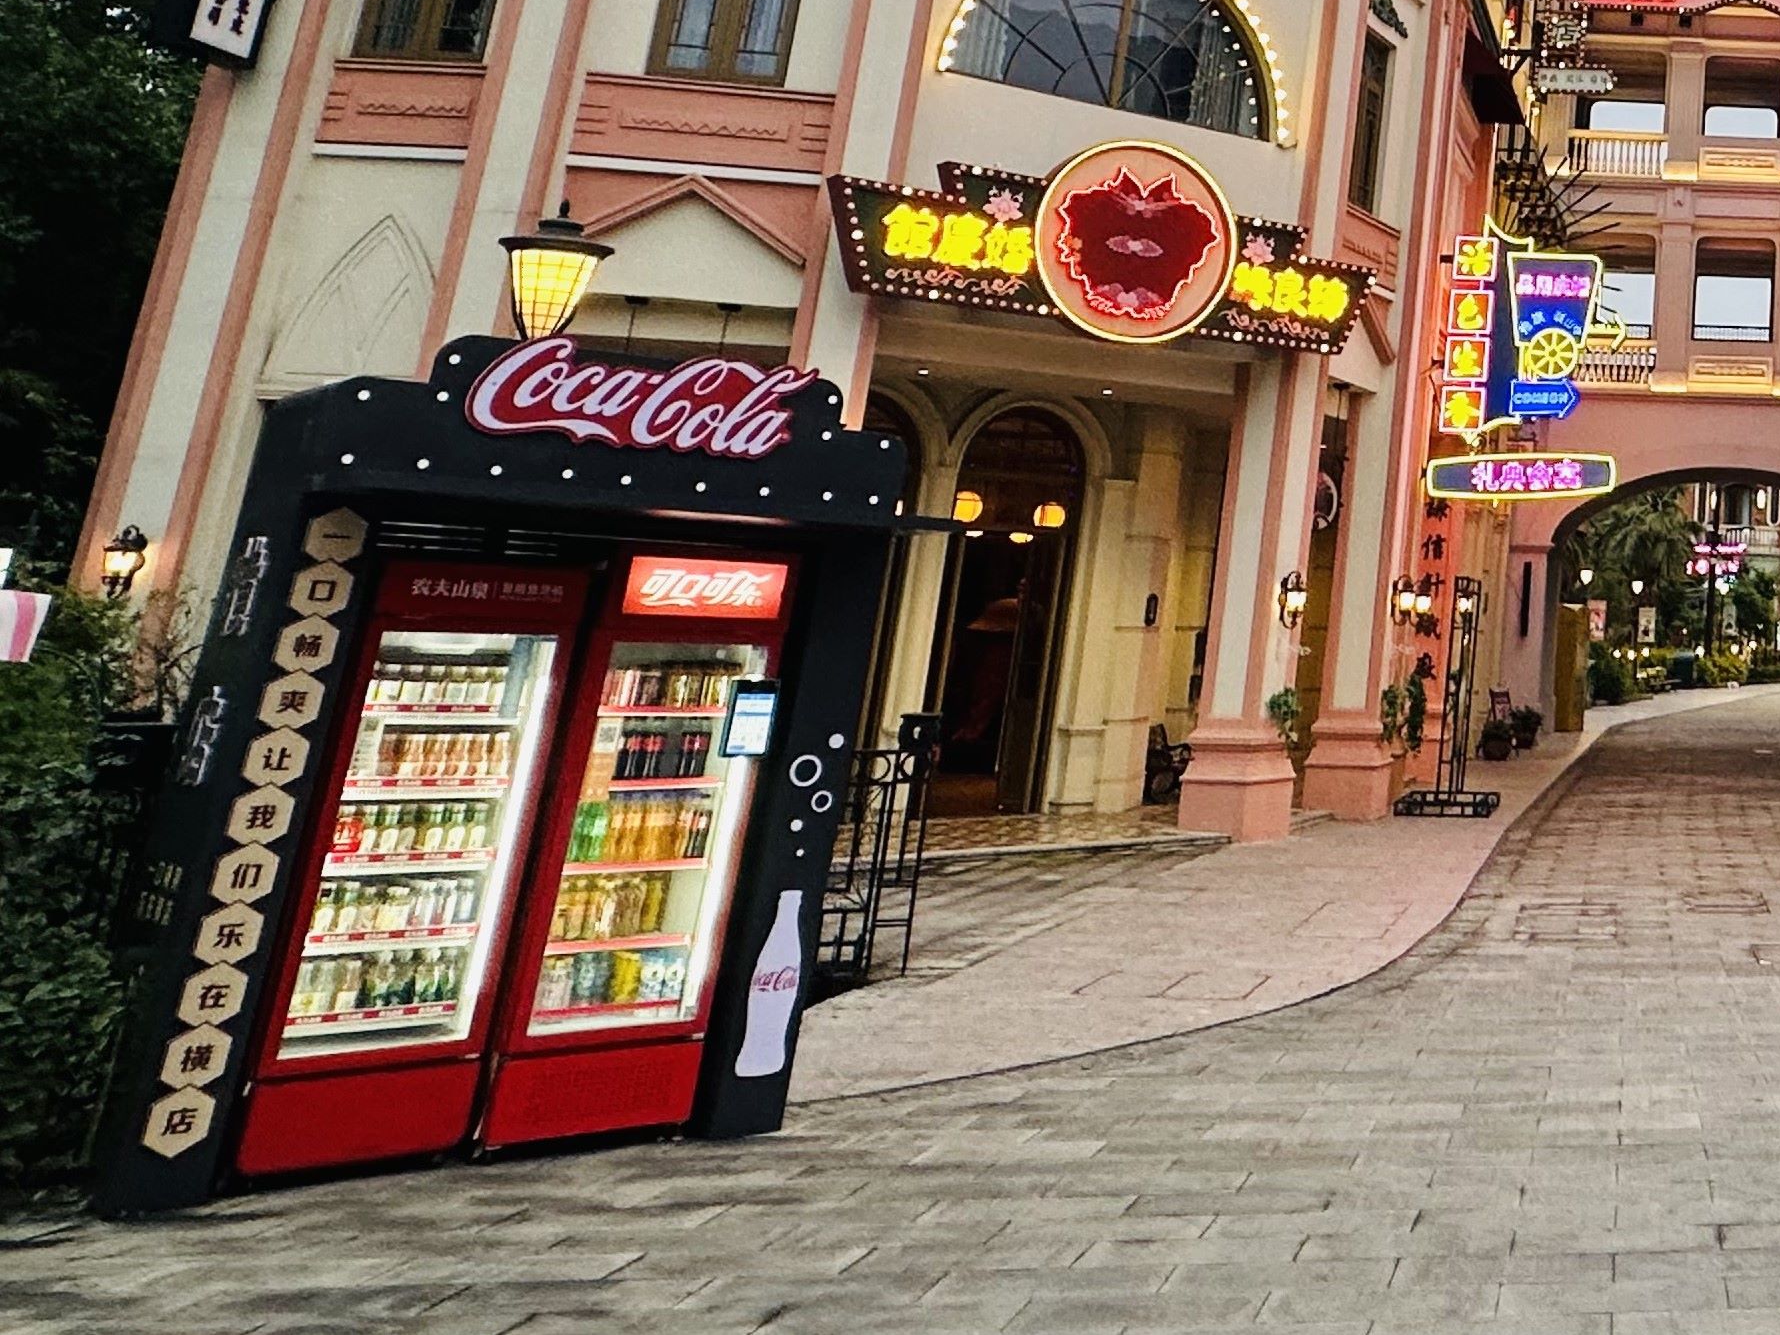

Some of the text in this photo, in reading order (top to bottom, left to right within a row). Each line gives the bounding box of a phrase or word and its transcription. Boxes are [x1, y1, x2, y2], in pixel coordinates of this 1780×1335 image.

[1445, 239, 1493, 428] 活色生香
[472, 337, 820, 456] Coca-Cola
[411, 576, 490, 601] 农夫山泉
[639, 568, 774, 608] 可口可乐
